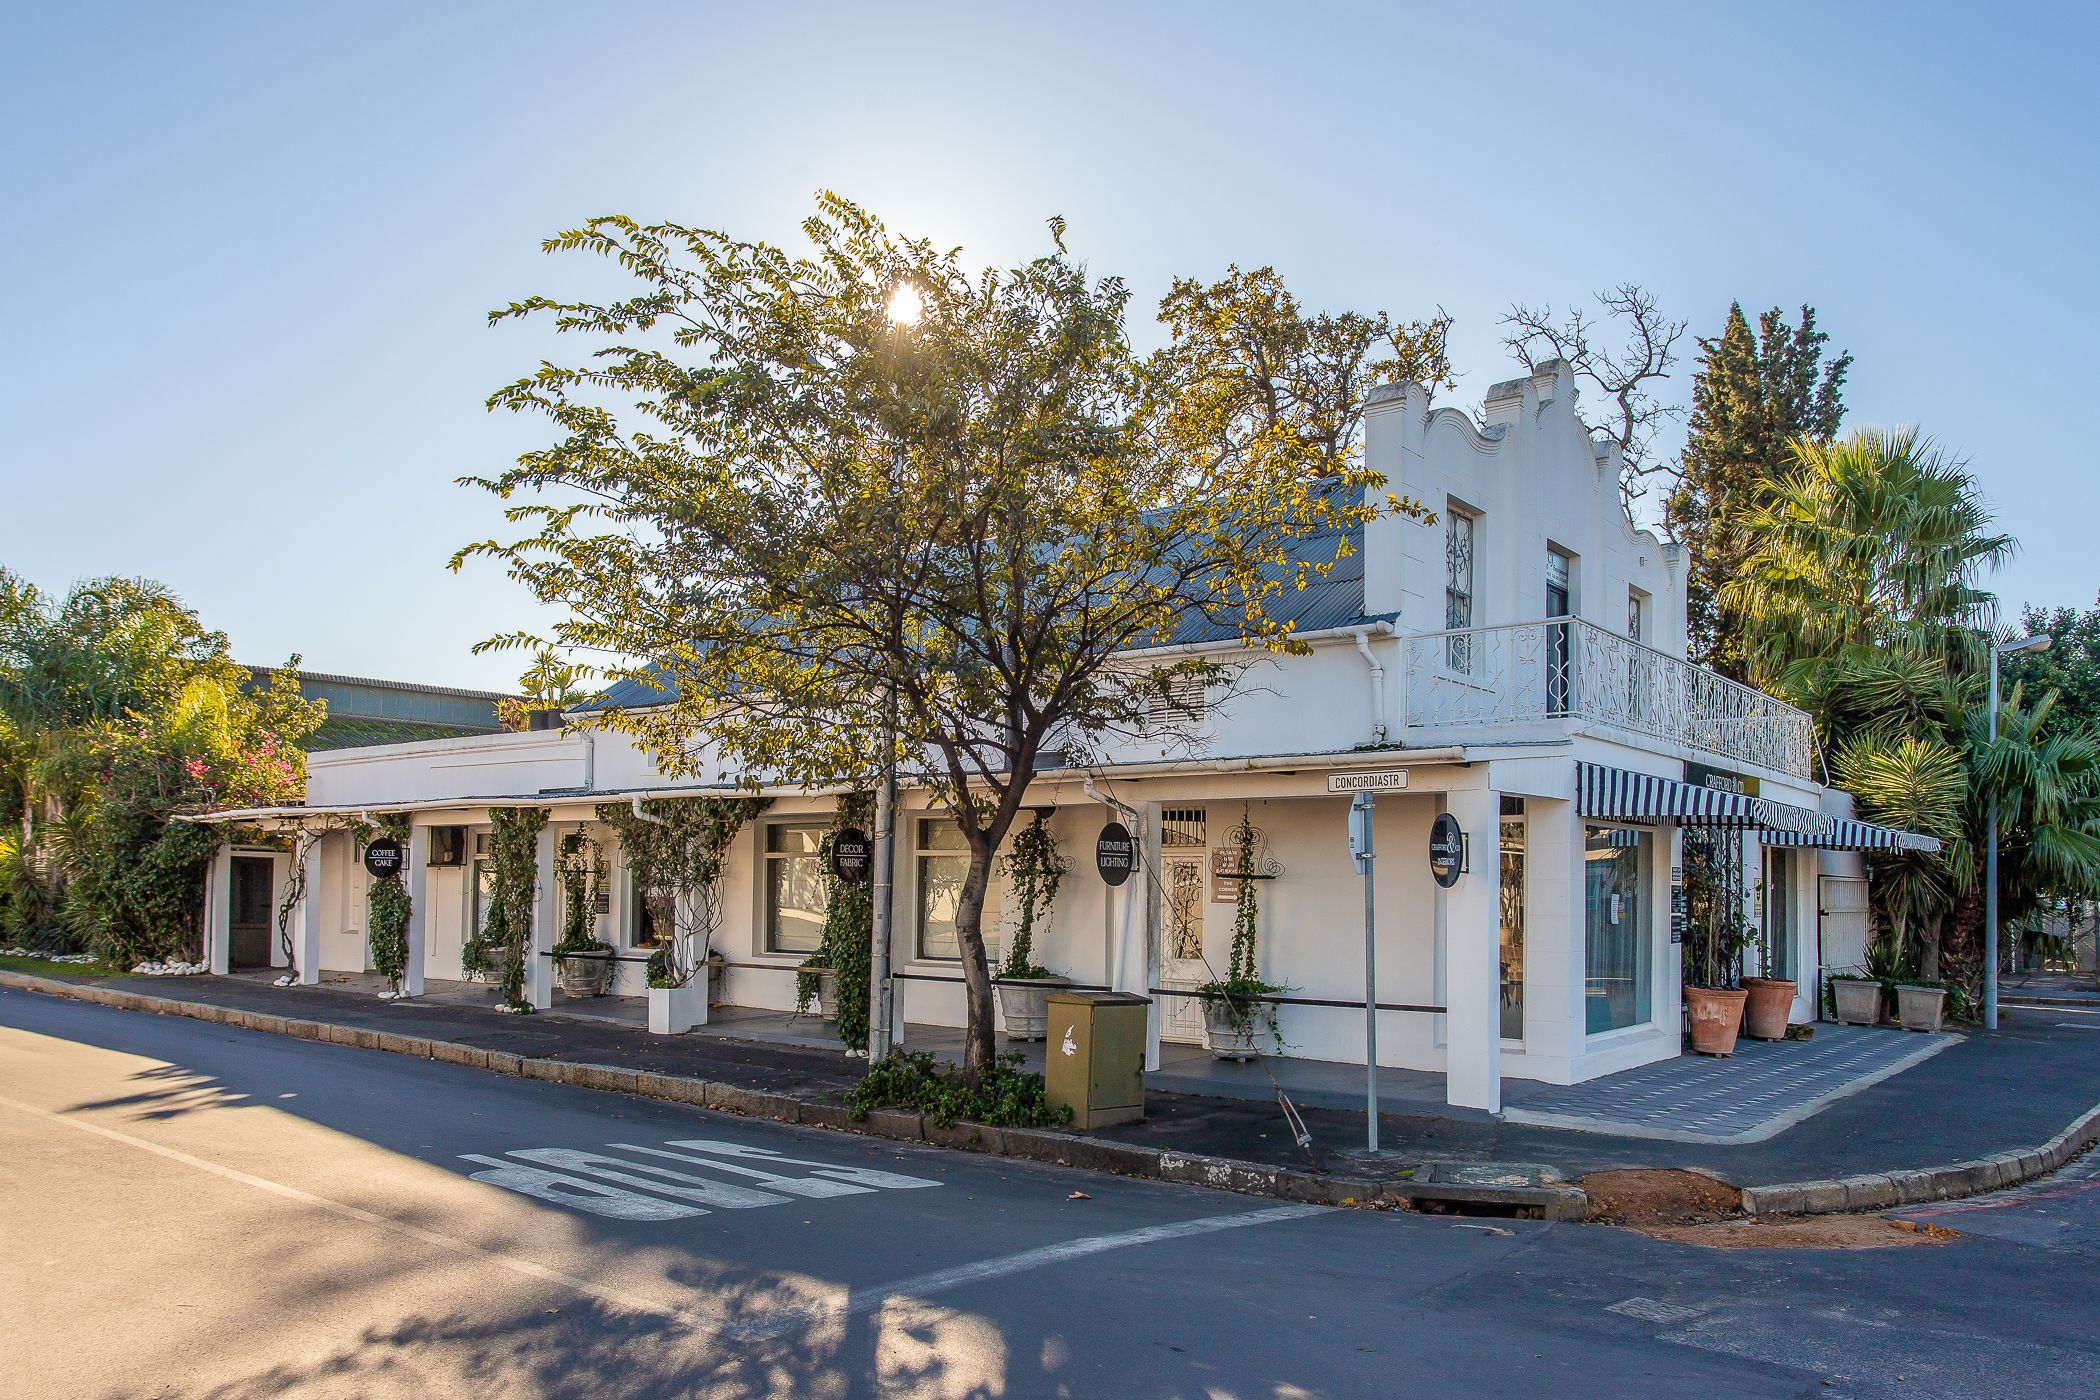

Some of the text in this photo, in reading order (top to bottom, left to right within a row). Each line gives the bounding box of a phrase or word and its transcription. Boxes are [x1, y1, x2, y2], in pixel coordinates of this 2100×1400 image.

[1335, 774, 1400, 789] CONCORDIASTR
[1705, 774, 1732, 791] CRAFFORD
[840, 844, 864, 854] DECOR
[1100, 841, 1130, 851] FURNITURE
[840, 858, 864, 867] FABRIC
[1100, 857, 1129, 868] LIGHTING
[457, 1140, 944, 1221] STOP
